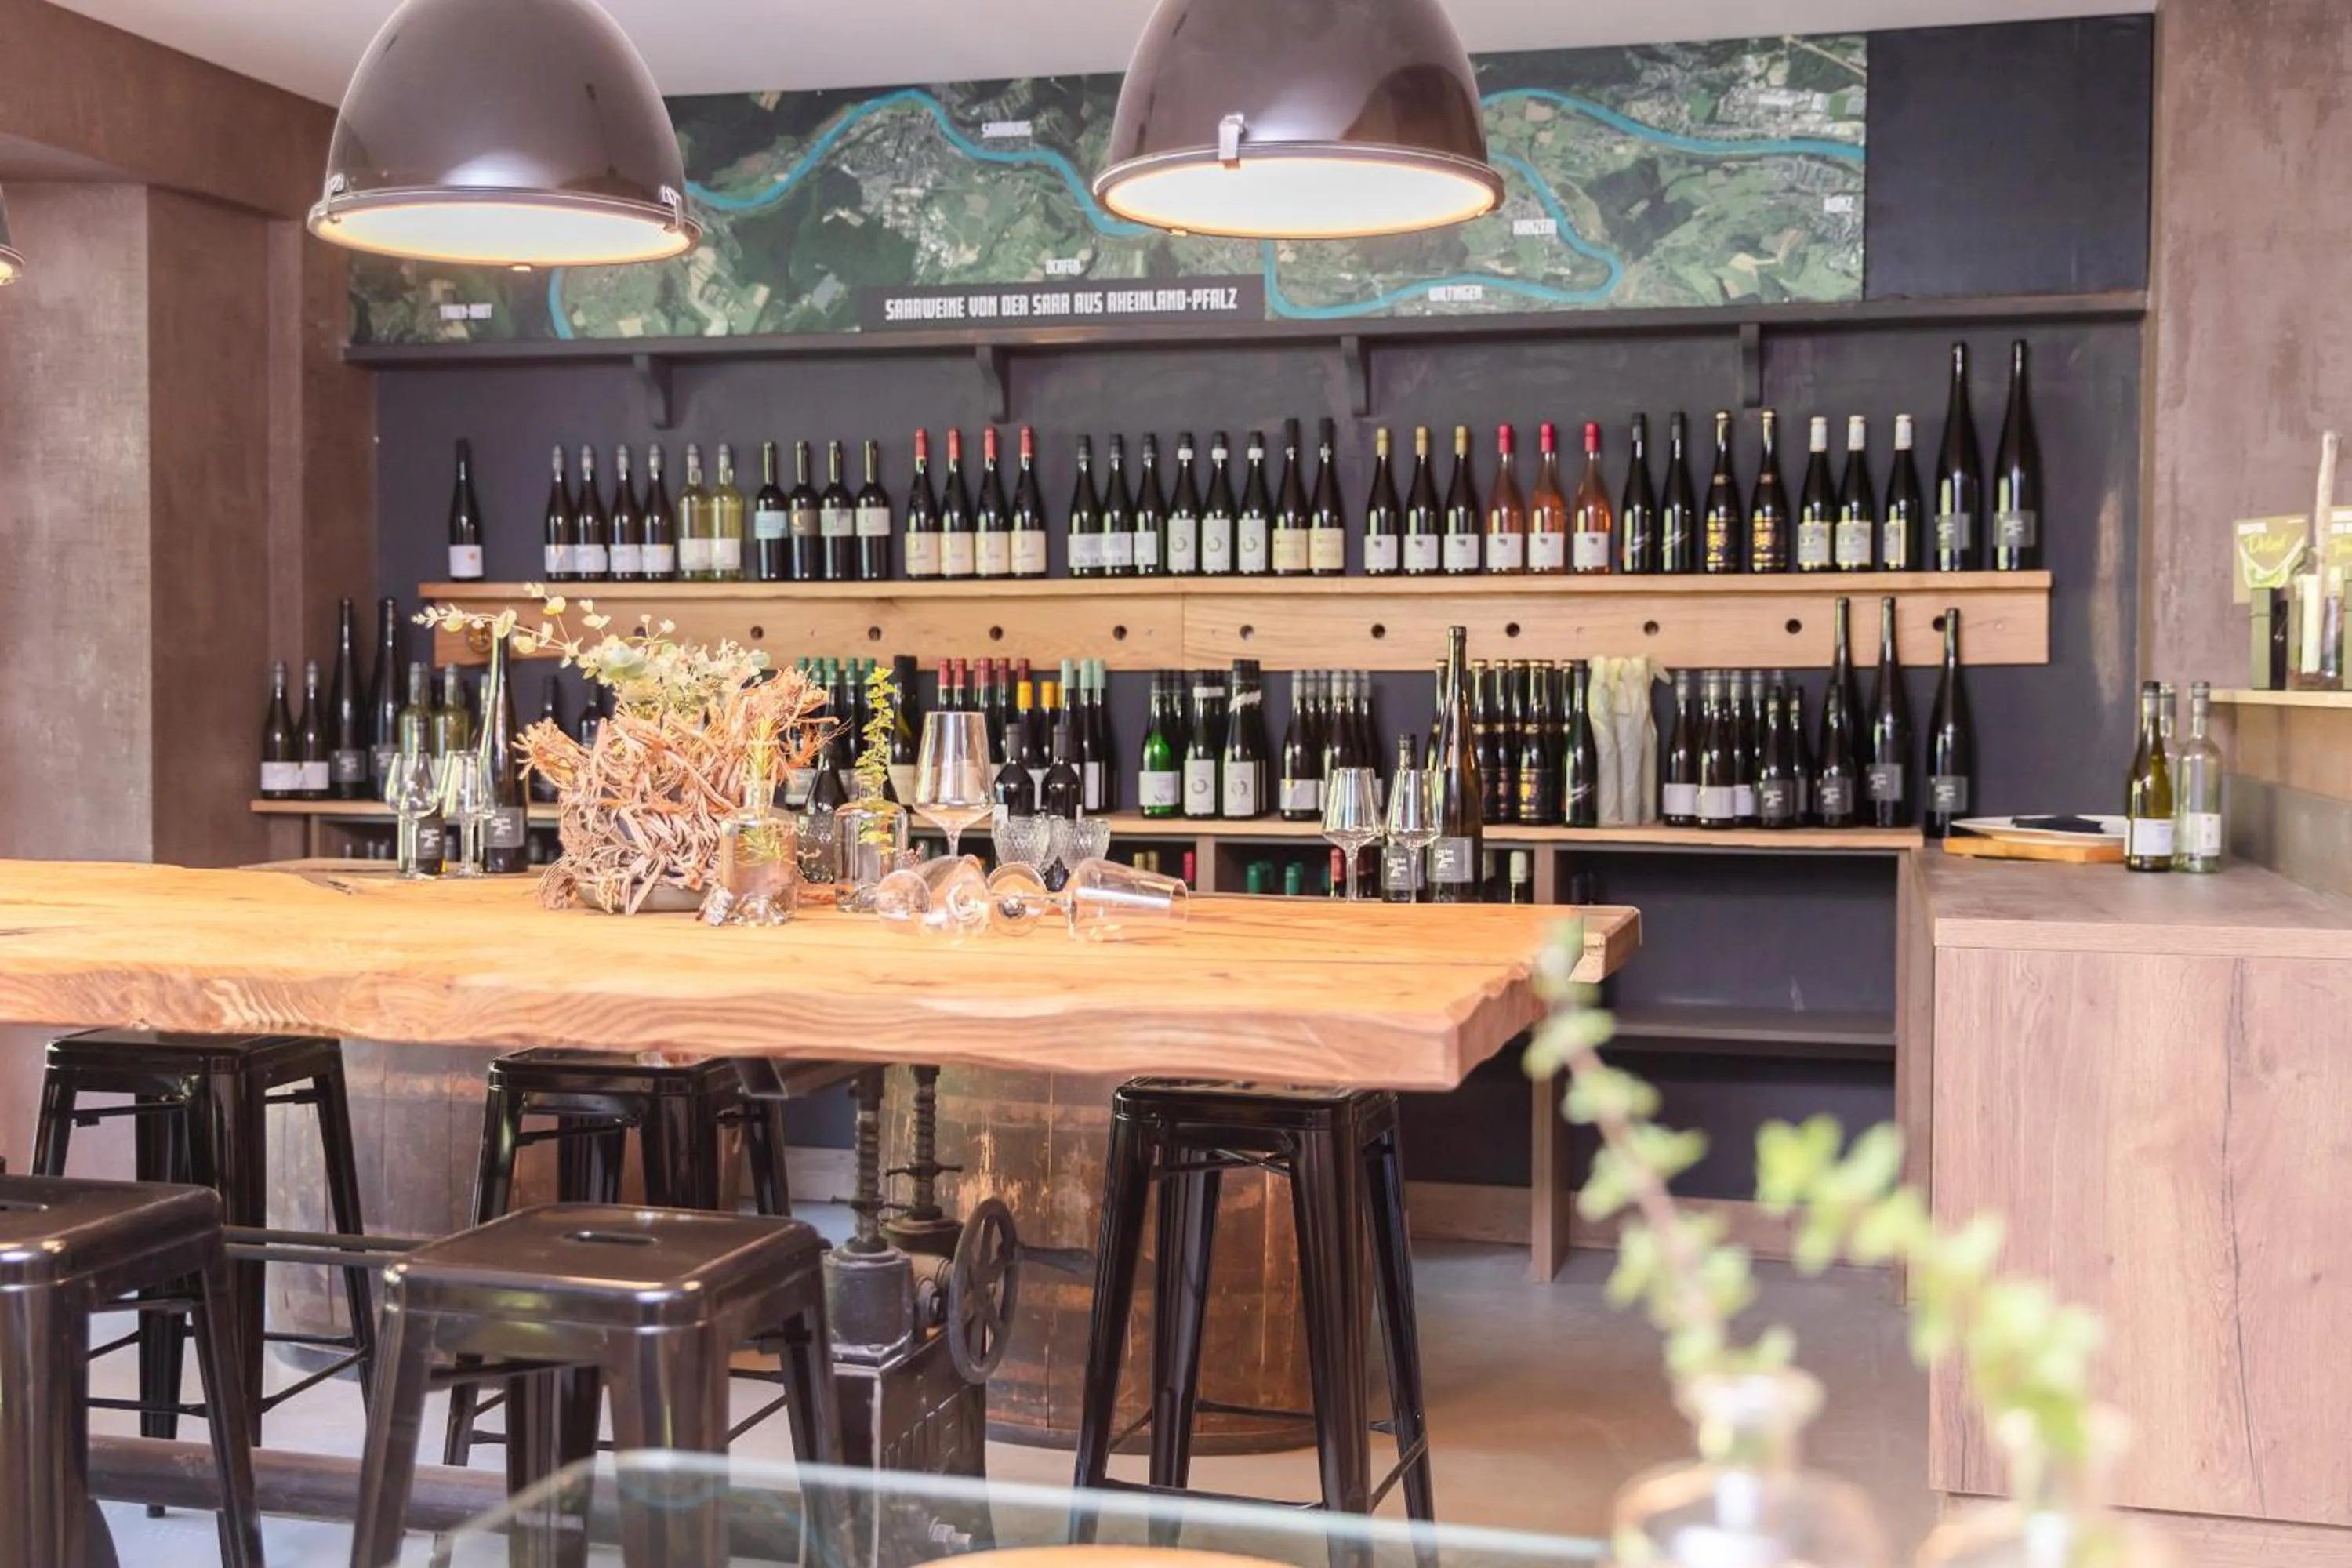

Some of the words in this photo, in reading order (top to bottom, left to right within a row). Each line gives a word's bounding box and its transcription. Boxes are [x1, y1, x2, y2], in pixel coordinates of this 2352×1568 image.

[885, 296, 965, 320] SAARWEINE
[968, 296, 998, 317] VON
[1001, 295, 1029, 316] DER
[1033, 292, 1069, 315] SAAR
[1074, 292, 1103, 314] AUS
[1107, 287, 1237, 313] RHEINLAND-PFALZ
